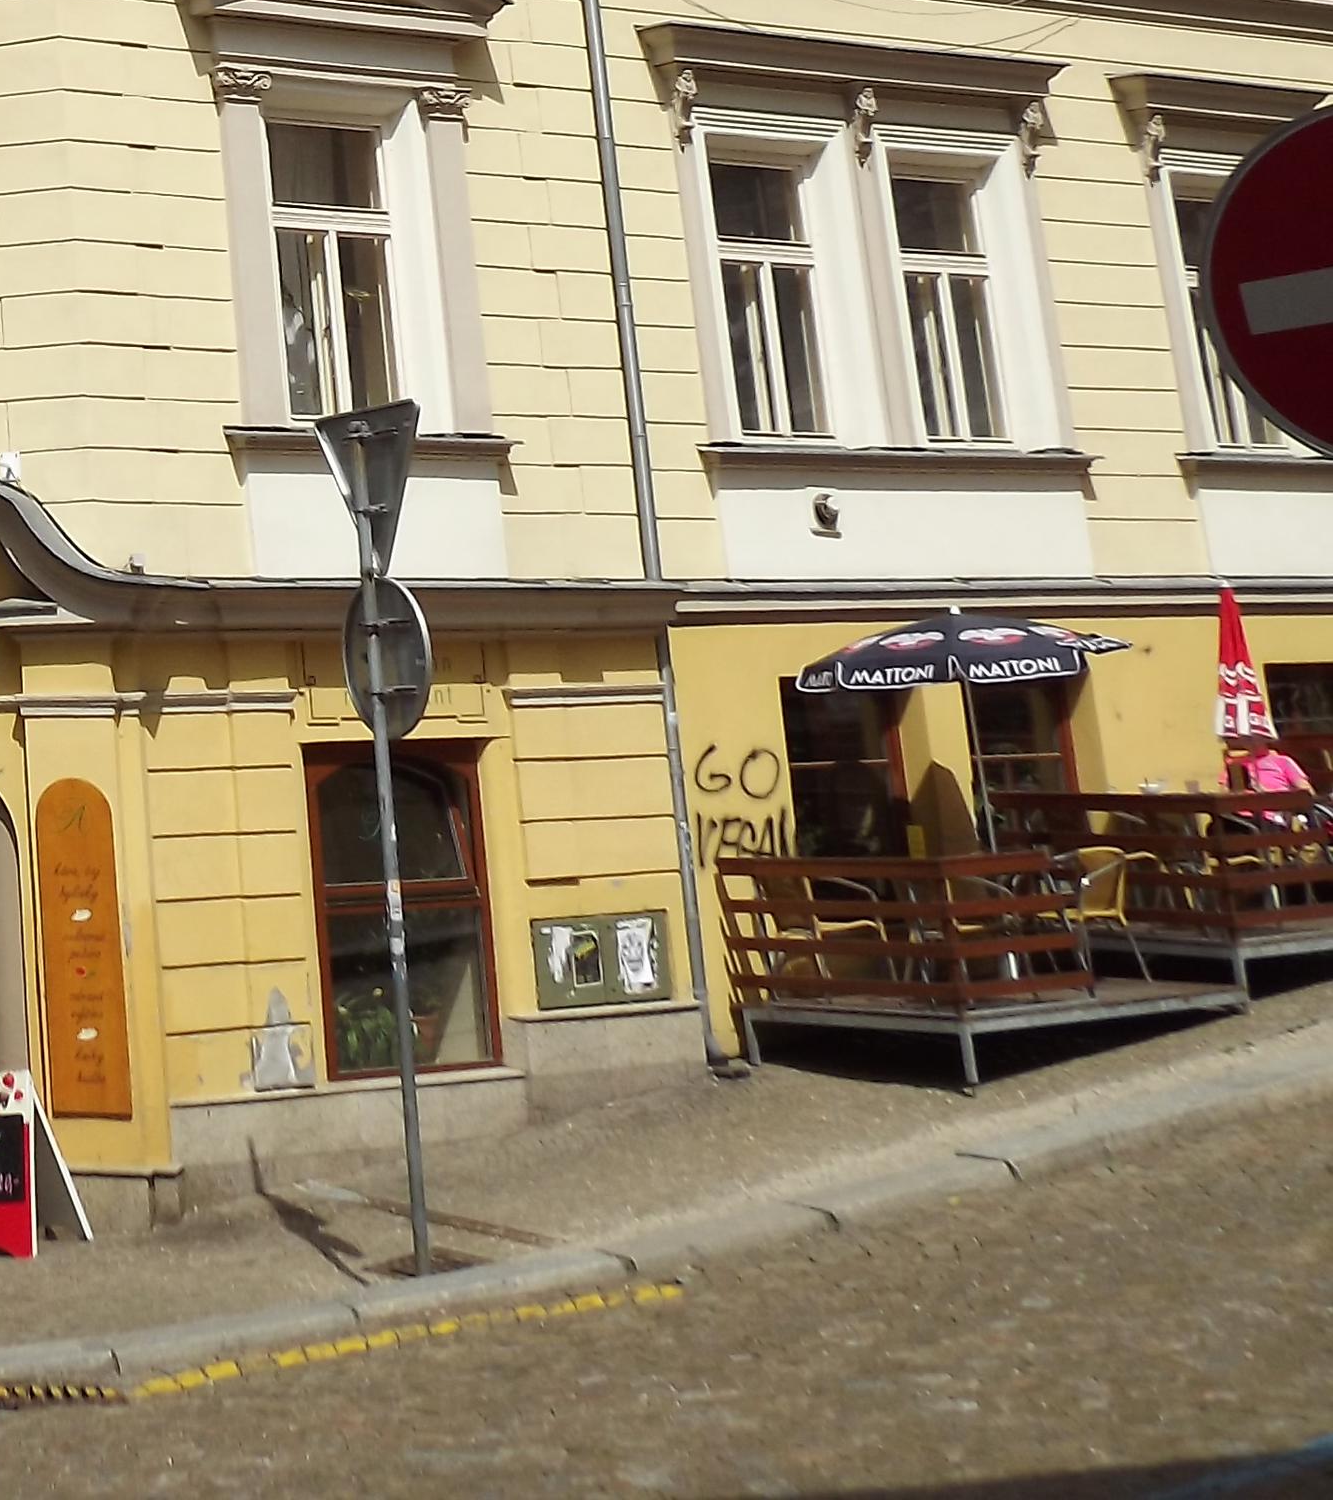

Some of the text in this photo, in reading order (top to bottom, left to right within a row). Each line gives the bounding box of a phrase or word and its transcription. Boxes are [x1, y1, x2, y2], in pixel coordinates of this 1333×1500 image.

[850, 665, 934, 685] MATTONI
[969, 657, 1061, 678] MATTONI
[695, 743, 780, 800] GO
